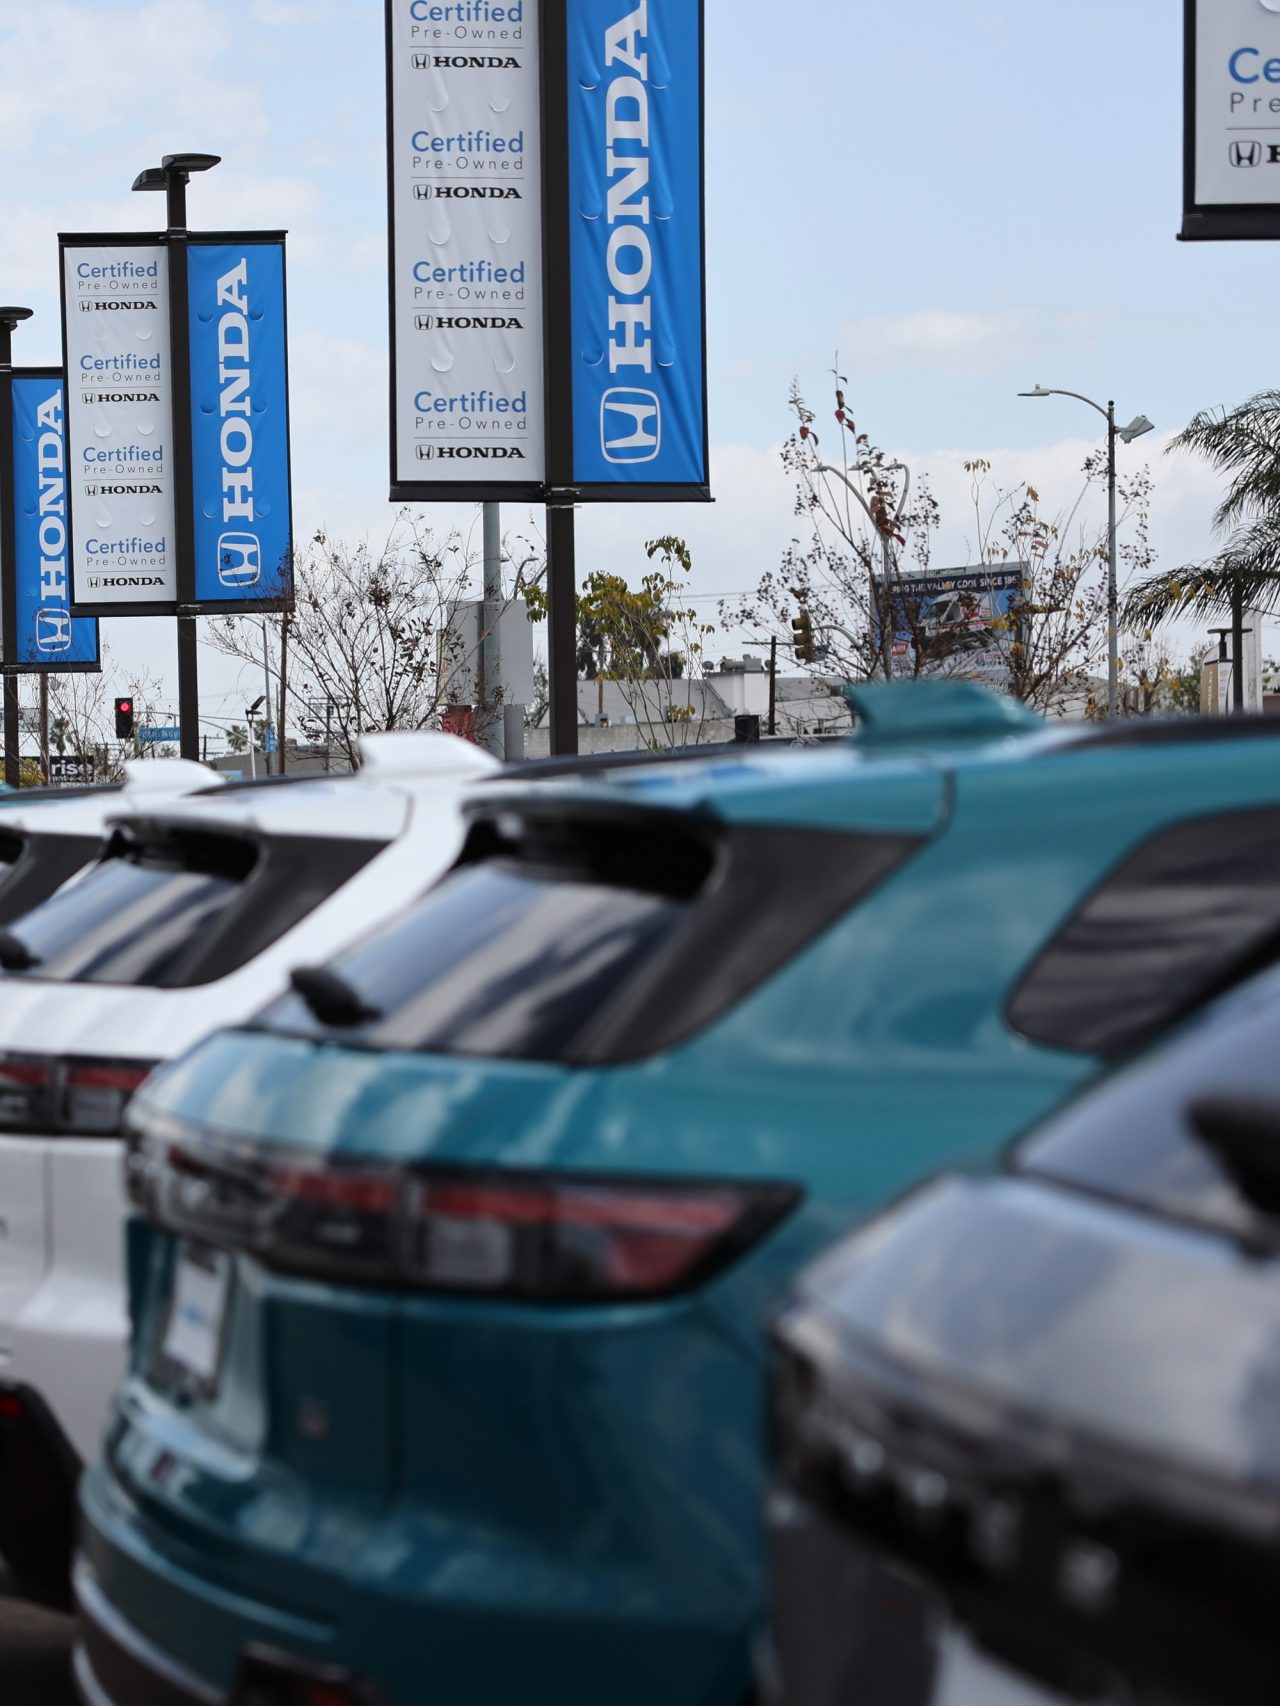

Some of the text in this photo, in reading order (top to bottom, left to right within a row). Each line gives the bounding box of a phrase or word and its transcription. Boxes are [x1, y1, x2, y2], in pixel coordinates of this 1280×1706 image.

[410, 0, 523, 22] Certified
[412, 25, 523, 40] Pre-Owned
[433, 56, 522, 68] HONDA
[412, 130, 523, 153] Certified
[413, 156, 524, 170] Pre-Owned
[435, 187, 522, 199] HONDA
[605, 0, 652, 373] HONDA
[77, 260, 158, 278] Certified
[413, 260, 525, 283] Certified
[79, 280, 158, 290] Pre-Owned
[415, 286, 525, 300] Pre-Owned
[95, 301, 158, 310] HONDA
[436, 317, 524, 329] HONDA
[80, 353, 160, 370] Certified
[82, 372, 161, 382] Pre-Owned
[217, 258, 253, 522] HONDA
[98, 393, 160, 402] HONDA
[414, 390, 526, 413] Certified
[416, 416, 527, 430] Pre-Owned
[83, 444, 164, 462] Certified
[437, 447, 526, 458] HONDA
[84, 464, 164, 474] Pre-Owned
[37, 389, 66, 600] HONDA
[100, 485, 163, 494] HONDA
[86, 537, 167, 554] Certified
[87, 556, 166, 566] Pre-Owned
[103, 577, 165, 586] HONDA
